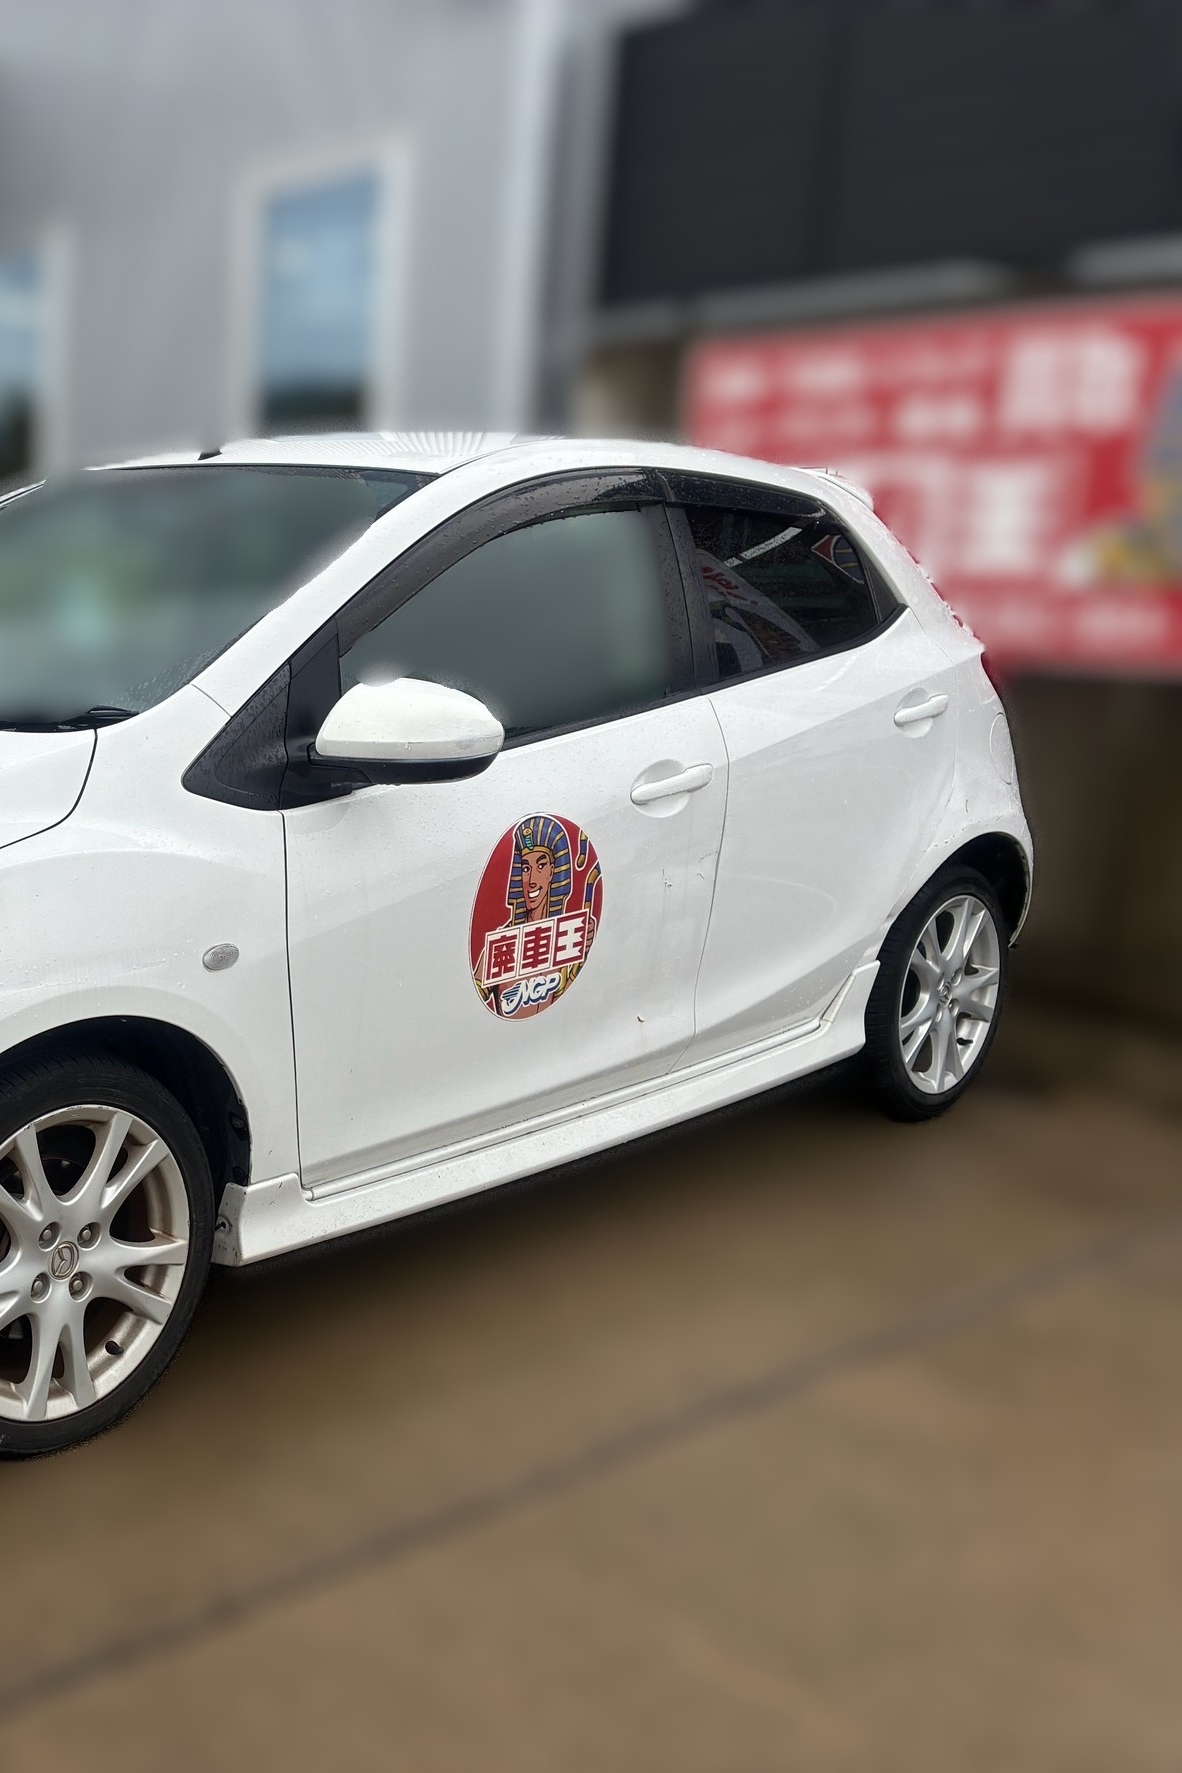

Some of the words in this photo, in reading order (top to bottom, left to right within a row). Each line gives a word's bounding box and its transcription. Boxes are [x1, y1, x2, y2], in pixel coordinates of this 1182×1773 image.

[486, 915, 586, 981] 廃車王
[502, 975, 561, 1013] NGP
